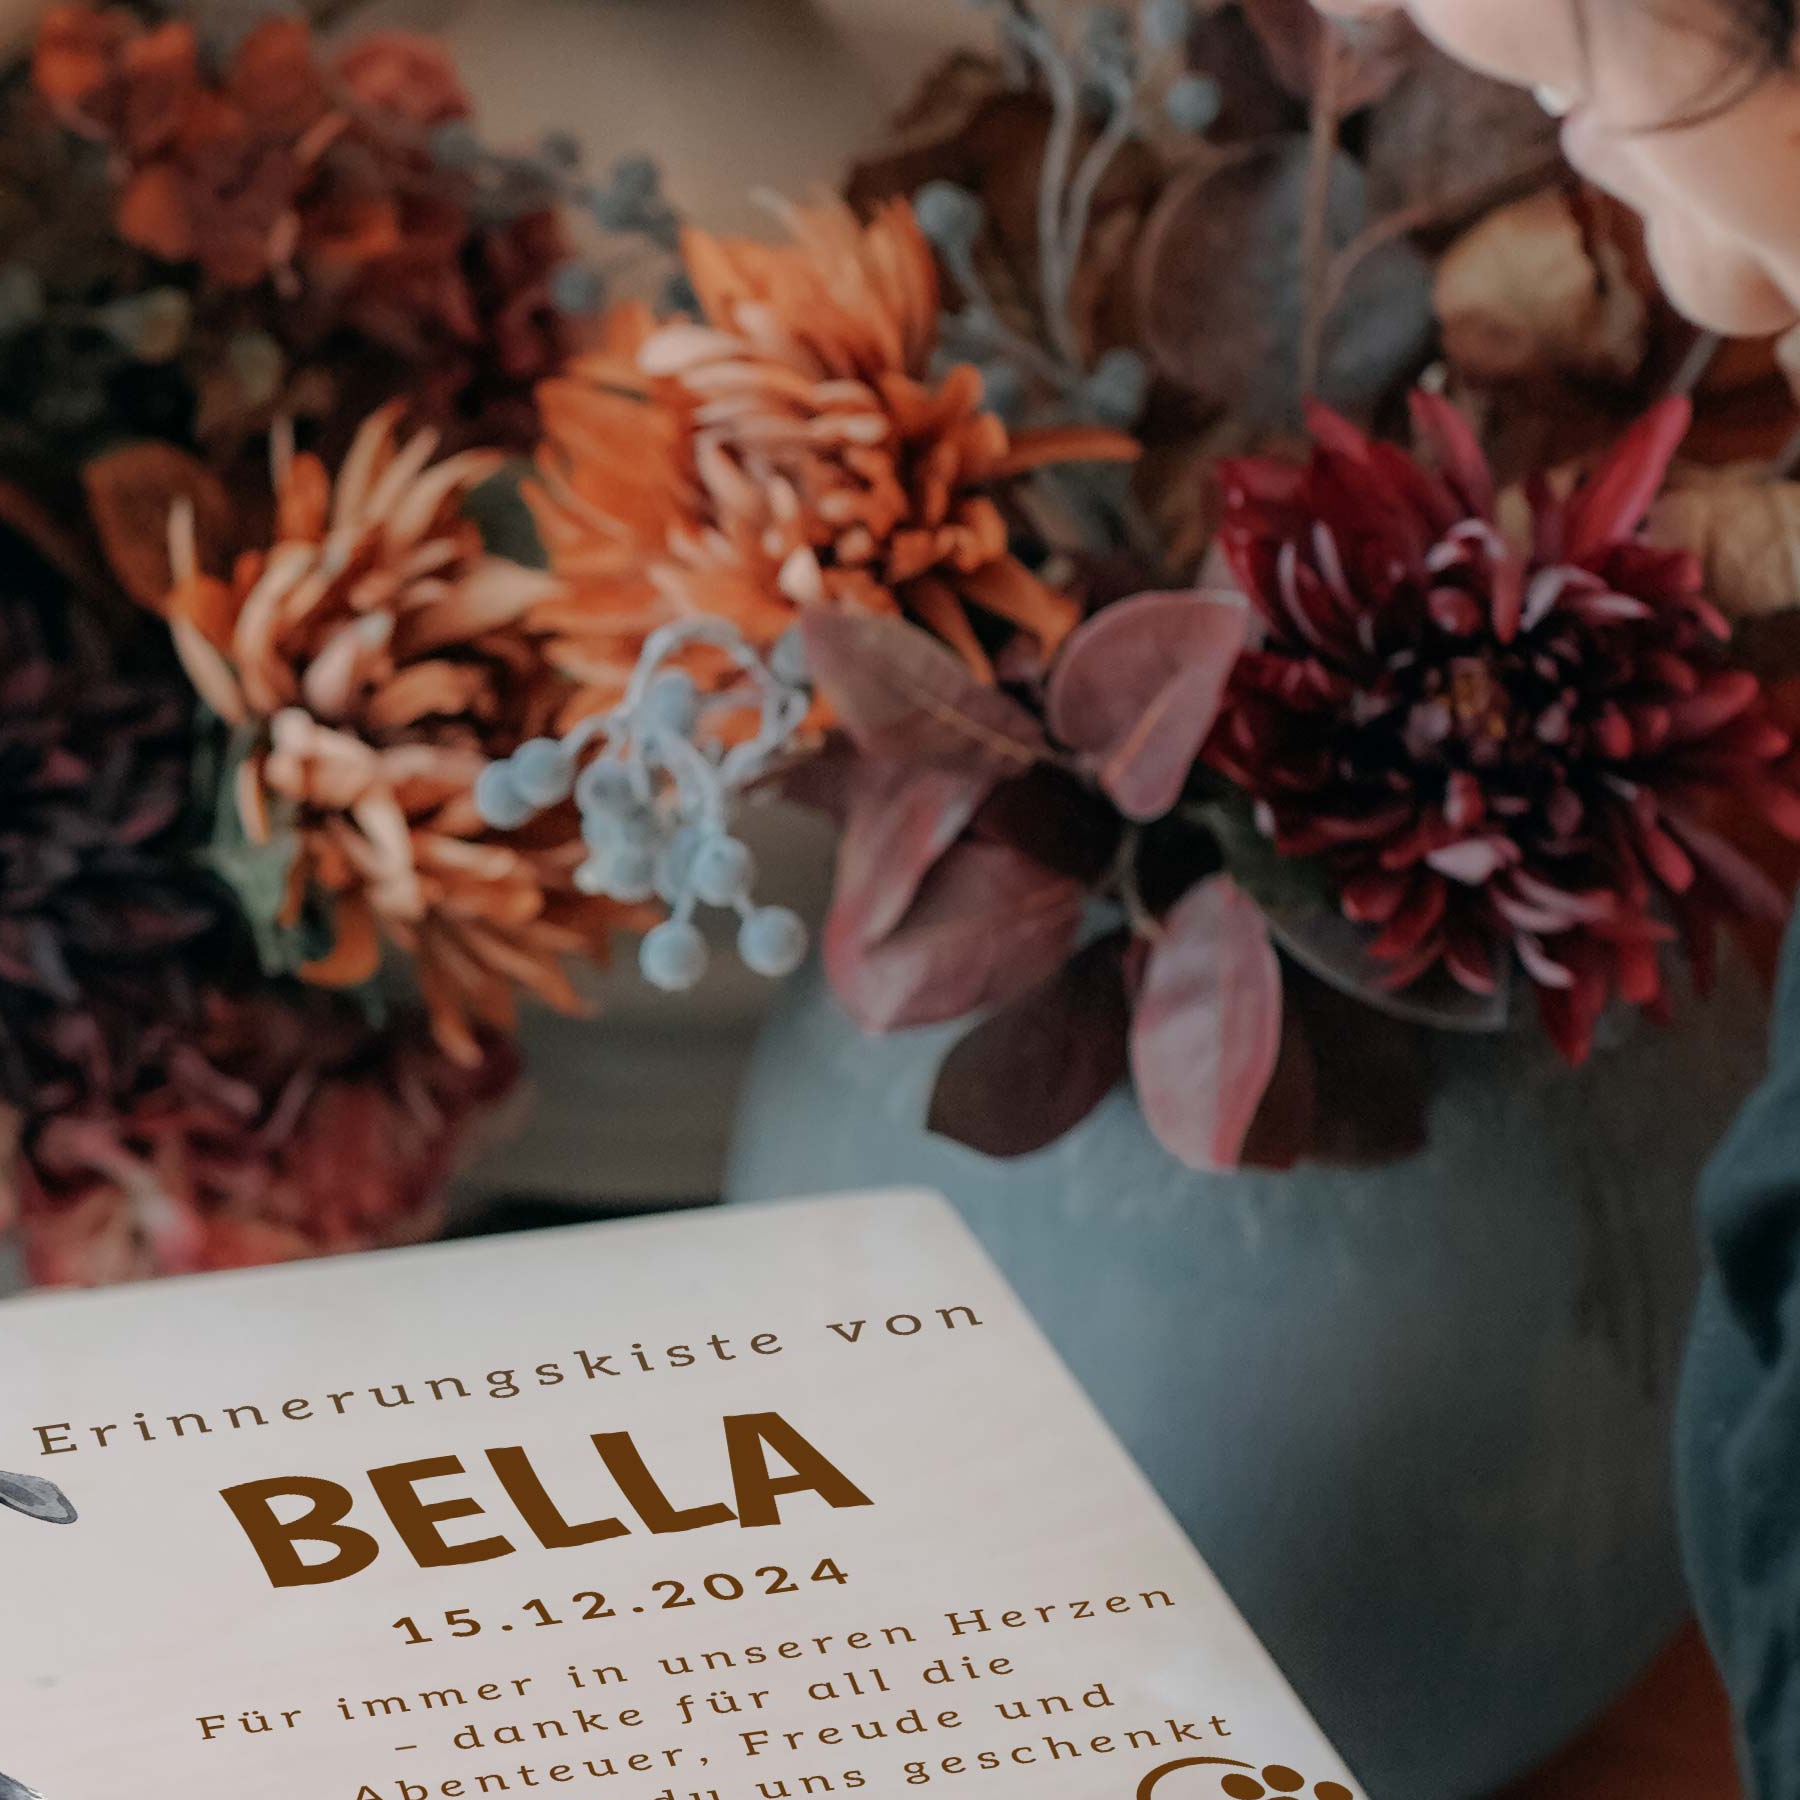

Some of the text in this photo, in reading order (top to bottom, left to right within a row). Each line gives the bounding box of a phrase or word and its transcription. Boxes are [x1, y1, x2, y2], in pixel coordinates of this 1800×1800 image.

[32, 1306, 983, 1455] Erinnerungskiste von
[218, 1412, 873, 1588] BELLA
[393, 1558, 848, 1645] 15.12.2024
[196, 1591, 1174, 1740] Für immer in unseren Herzen
[454, 1710, 643, 1749] danke
[676, 1691, 769, 1724] für
[808, 1669, 888, 1700] all
[923, 1656, 1014, 1684] die
[738, 1709, 962, 1756] Freude
[994, 1683, 1112, 1719] und
[755, 1770, 865, 1799] uns
[904, 1716, 1231, 1784] geschenkt
